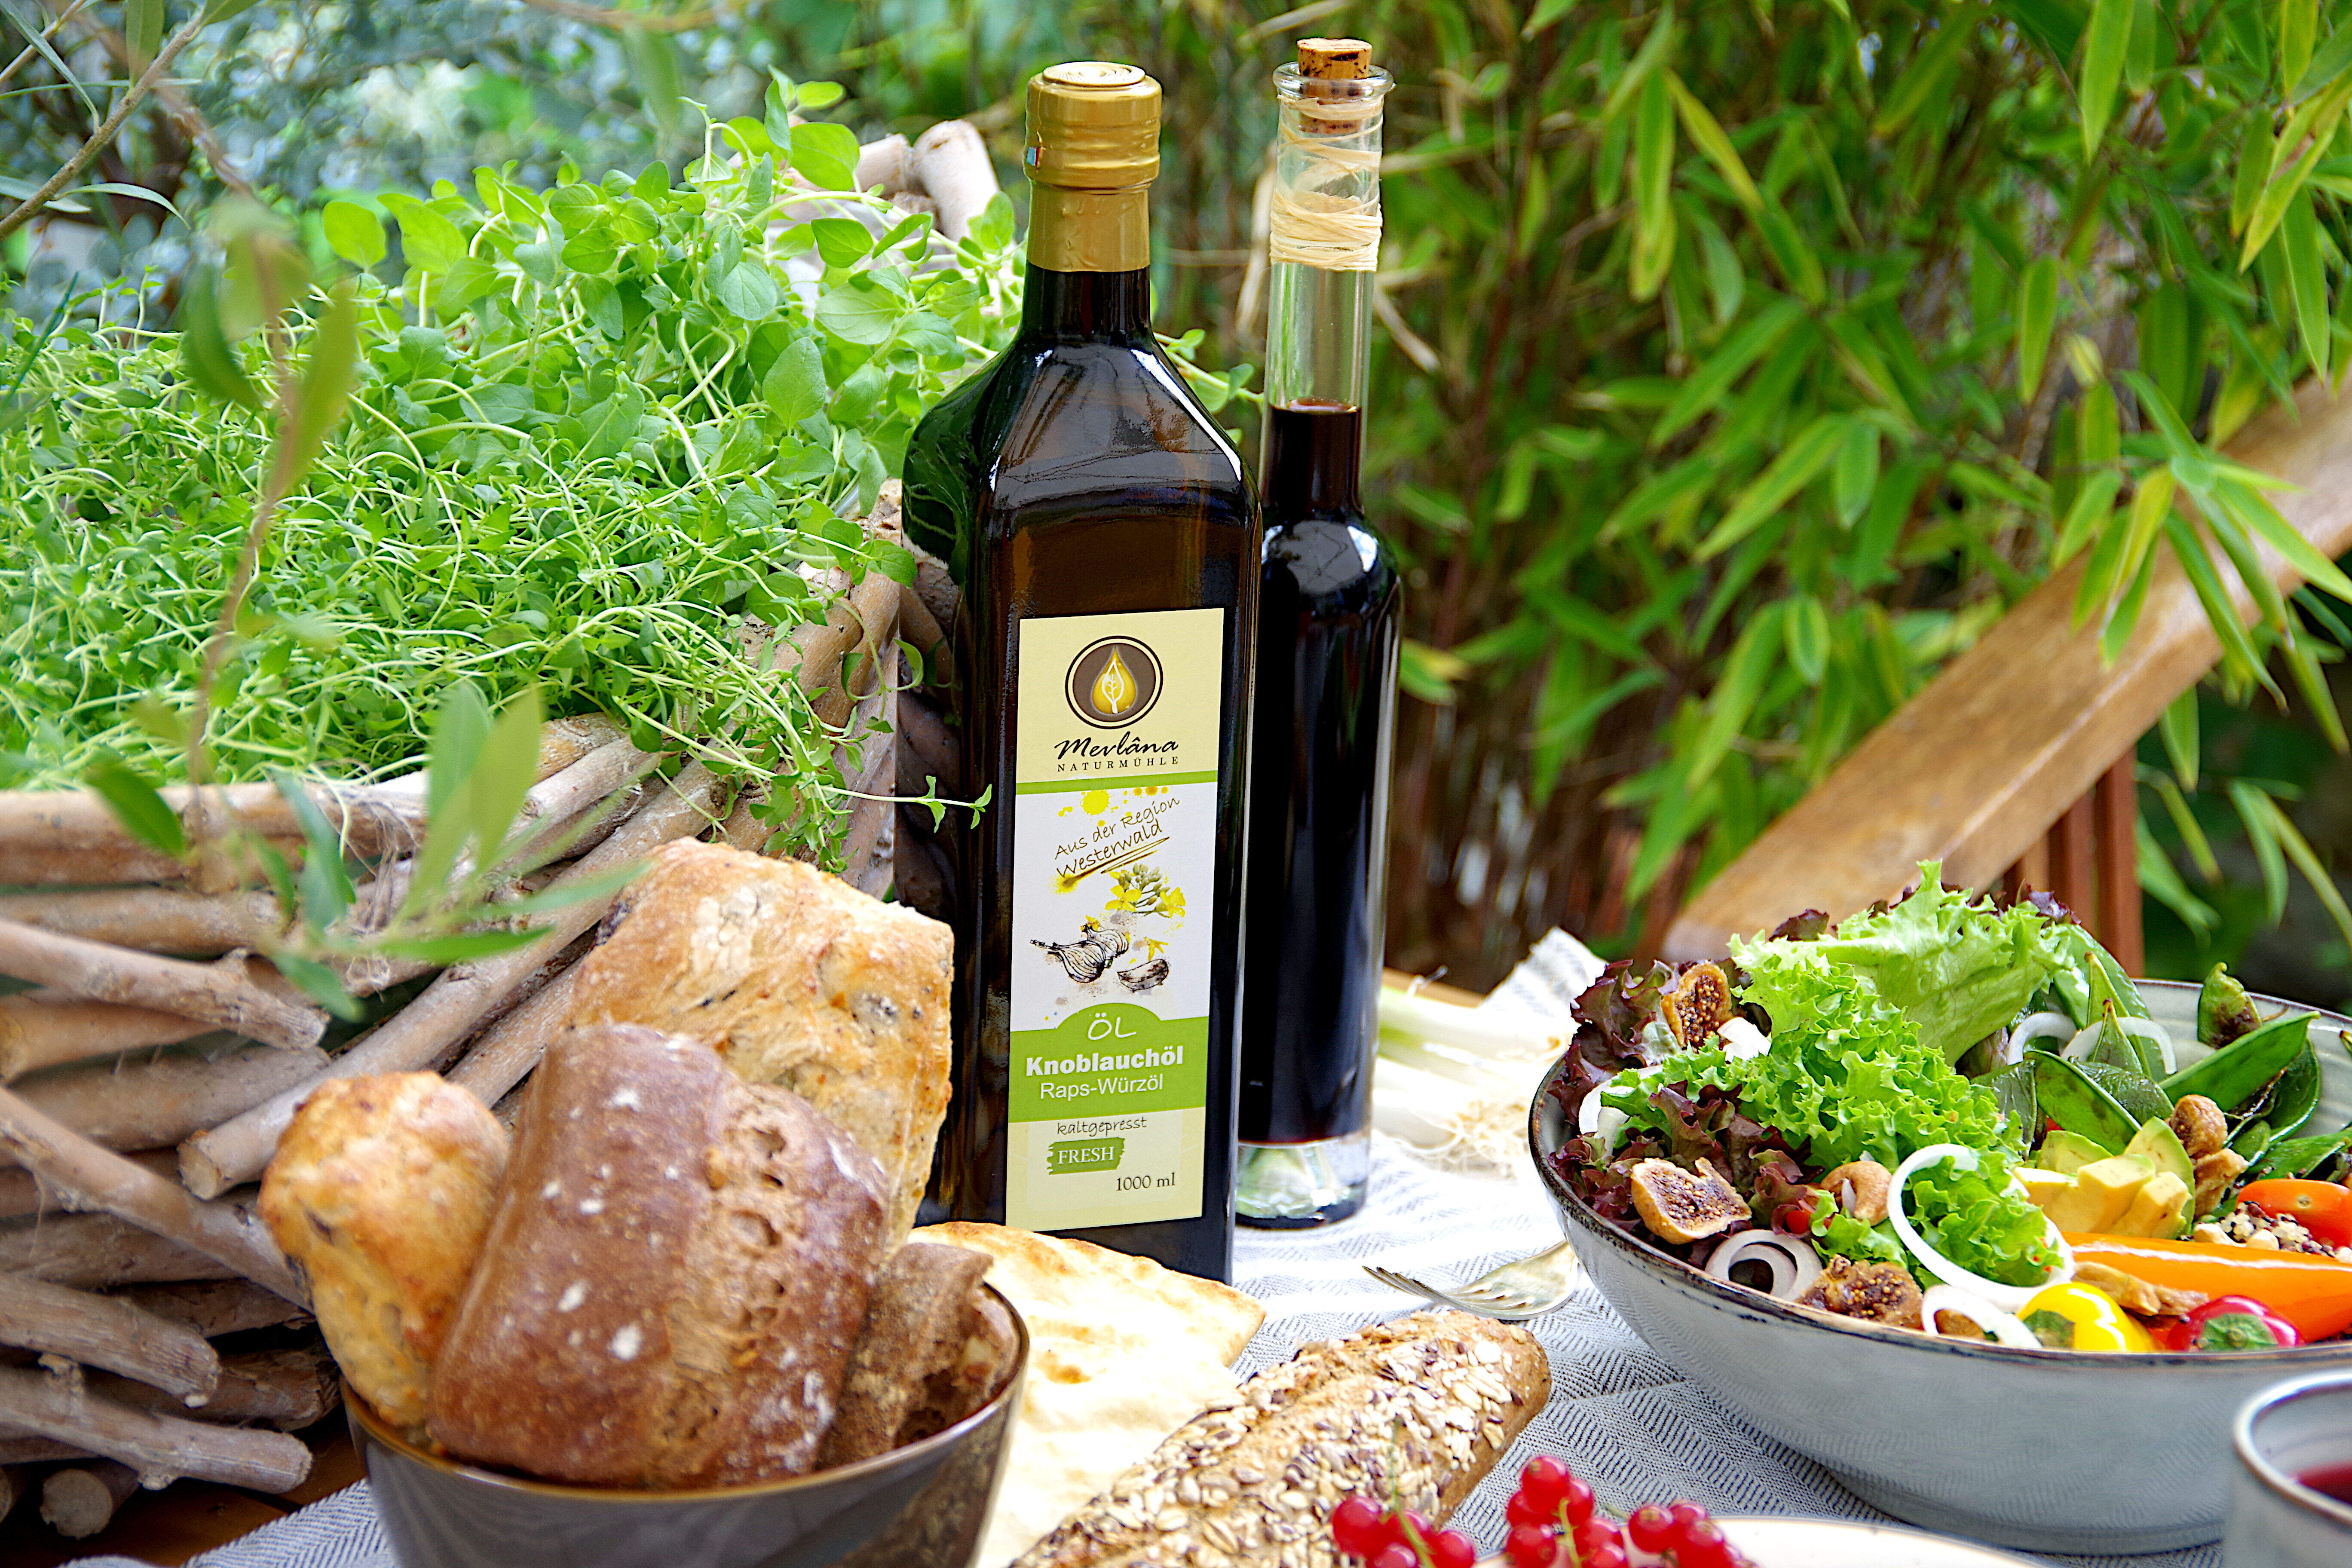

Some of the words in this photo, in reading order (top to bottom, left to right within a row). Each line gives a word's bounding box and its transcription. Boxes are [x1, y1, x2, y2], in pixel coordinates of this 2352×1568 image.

[1054, 731, 1179, 760] Mevlâna
[1057, 756, 1179, 772] NATURMÜHLE
[1055, 837, 1087, 859] Aus
[1093, 823, 1117, 842] der
[1121, 798, 1180, 829] Region
[1057, 818, 1162, 878] Westerwald
[1087, 1012, 1136, 1041] ÖL
[1026, 1045, 1183, 1076] Knoblauchöl
[1040, 1073, 1163, 1101] Raps-Würzöl
[1057, 1117, 1148, 1137] kaltgepresst
[1057, 1146, 1115, 1165] FRESH
[1116, 1175, 1151, 1191] 1000
[1157, 1172, 1176, 1187] ml
